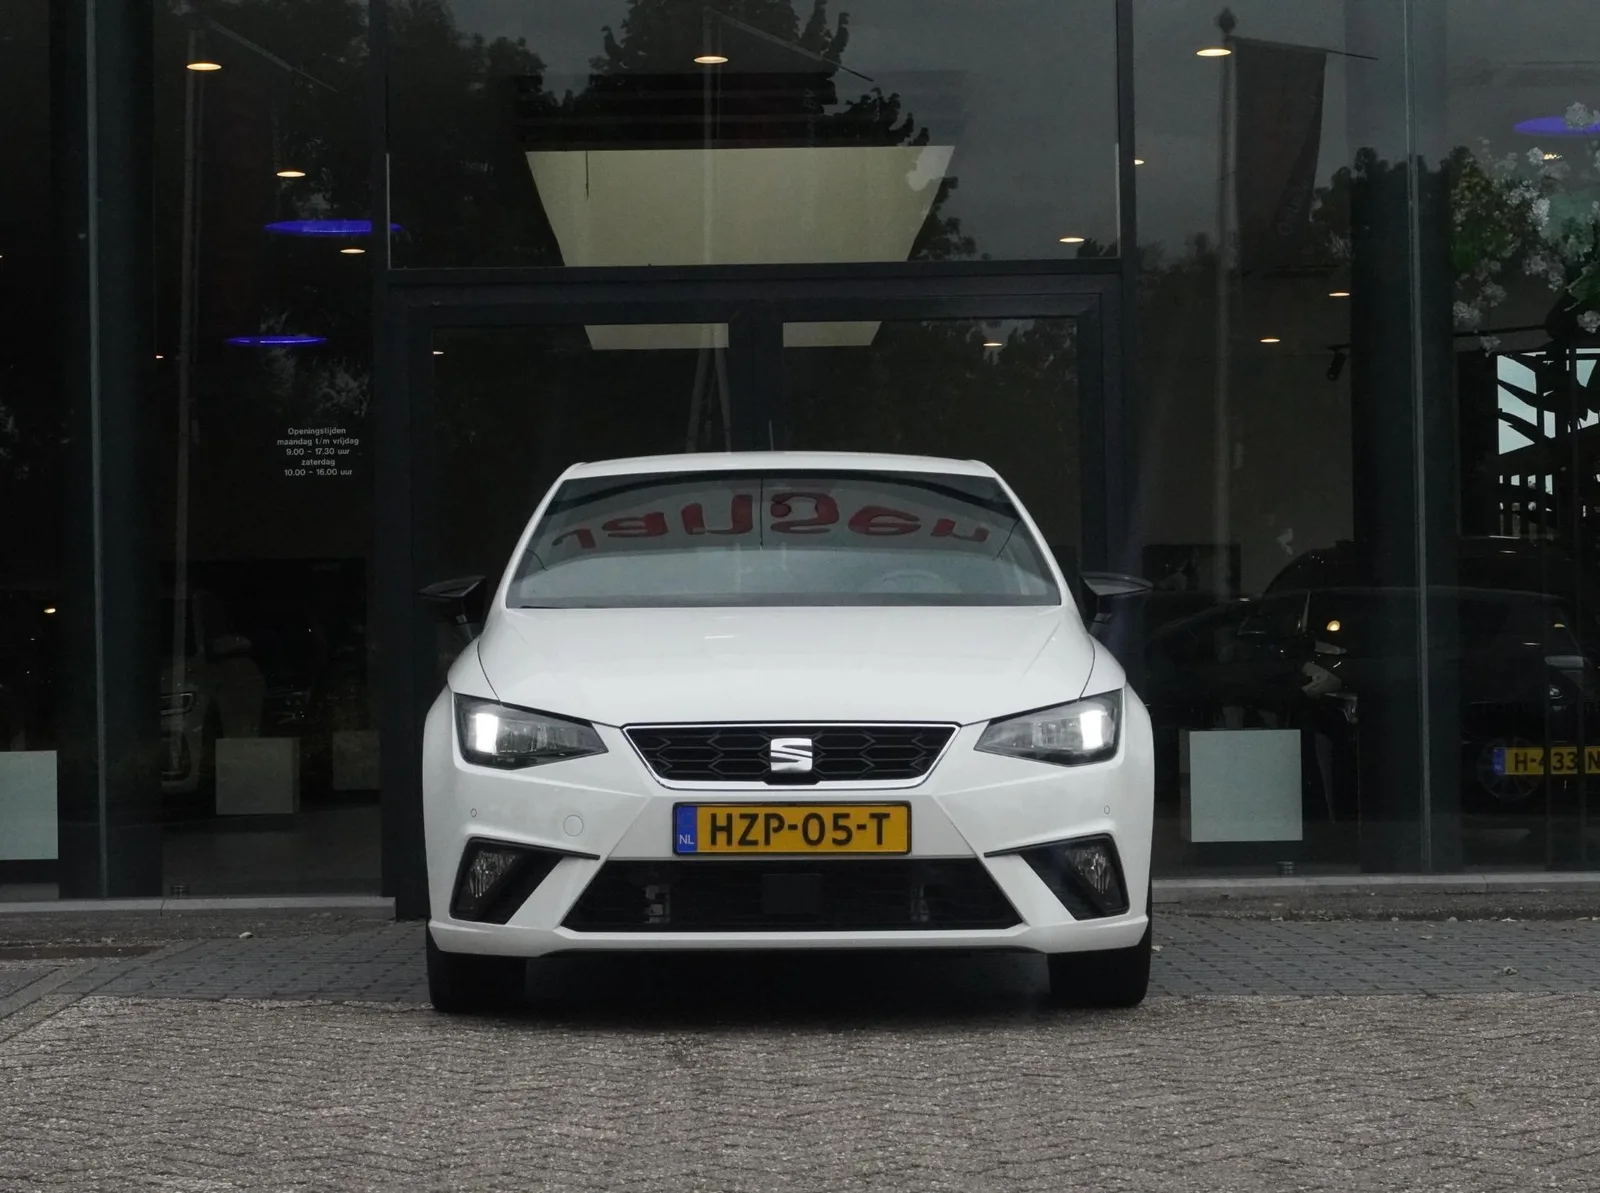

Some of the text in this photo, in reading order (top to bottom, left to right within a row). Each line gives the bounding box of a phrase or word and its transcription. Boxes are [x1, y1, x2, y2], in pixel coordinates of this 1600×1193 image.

[287, 427, 347, 436] Openingstijden
[276, 438, 313, 446] maandag
[332, 437, 360, 446] vrijdag
[285, 448, 305, 456] 9.00
[314, 447, 335, 455] 17.30
[301, 458, 336, 467] zaterdag
[316, 468, 338, 476] 16.00
[710, 812, 891, 847] HZP-05-T
[679, 834, 694, 845] NL
